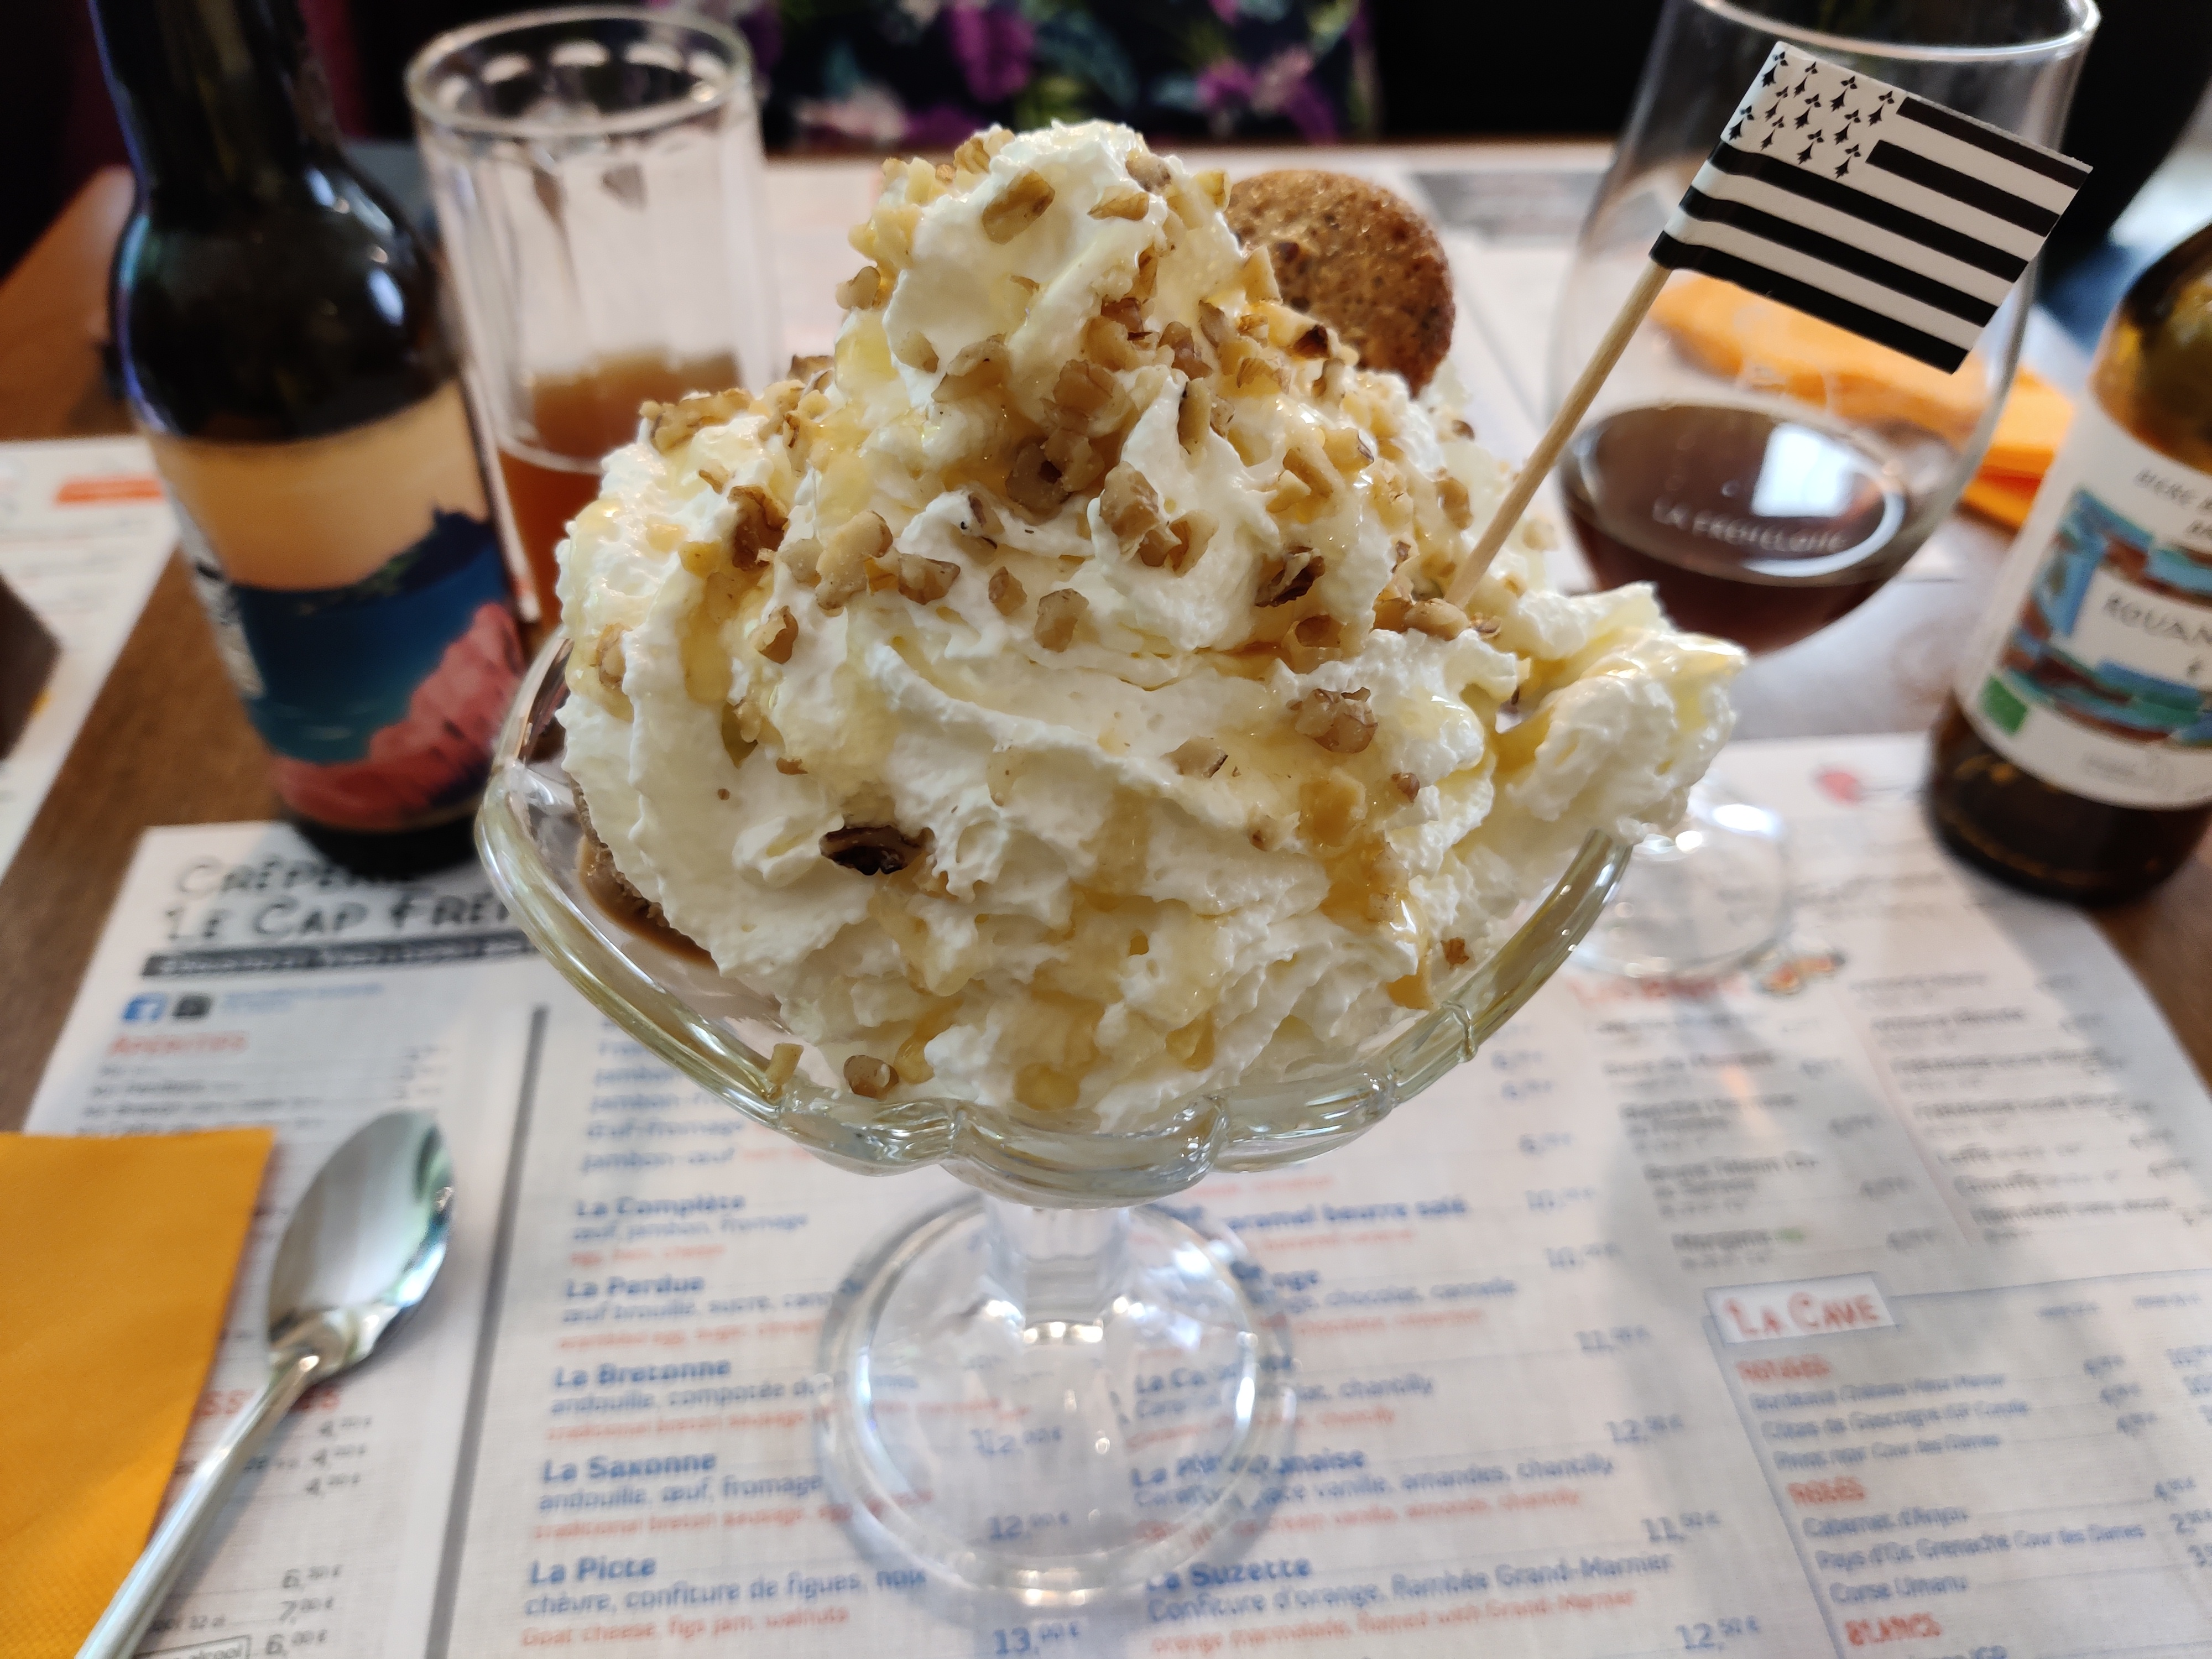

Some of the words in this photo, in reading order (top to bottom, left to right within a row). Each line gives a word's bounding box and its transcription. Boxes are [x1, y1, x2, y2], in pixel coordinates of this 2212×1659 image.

[254, 895, 370, 935] CAP
[576, 1199, 607, 1216] La
[616, 1194, 746, 1215] Complète
[1323, 1200, 1407, 1221] beurre
[566, 1277, 599, 1298] La
[607, 1274, 705, 1296] Perdue
[1724, 1298, 1782, 1337] LA
[1787, 1291, 1879, 1328] CAVE
[554, 1366, 589, 1389] La
[598, 1359, 732, 1385] Bretonne
[1135, 1373, 1164, 1396] La
[544, 1458, 578, 1484] La
[587, 1452, 717, 1480] Saxonne
[1130, 1467, 1168, 1488] La
[721, 1473, 825, 1499] fromage
[529, 1559, 567, 1587] La
[576, 1554, 658, 1582] Picte
[1188, 1555, 1312, 1589] Suzette
[1815, 1550, 1867, 1572] Pays
[523, 1589, 619, 1619] chèvre,
[625, 1580, 742, 1609] confiture
[749, 1572, 780, 1598] de
[785, 1568, 868, 1600] figues,
[1147, 1593, 1267, 1624] Confiture
